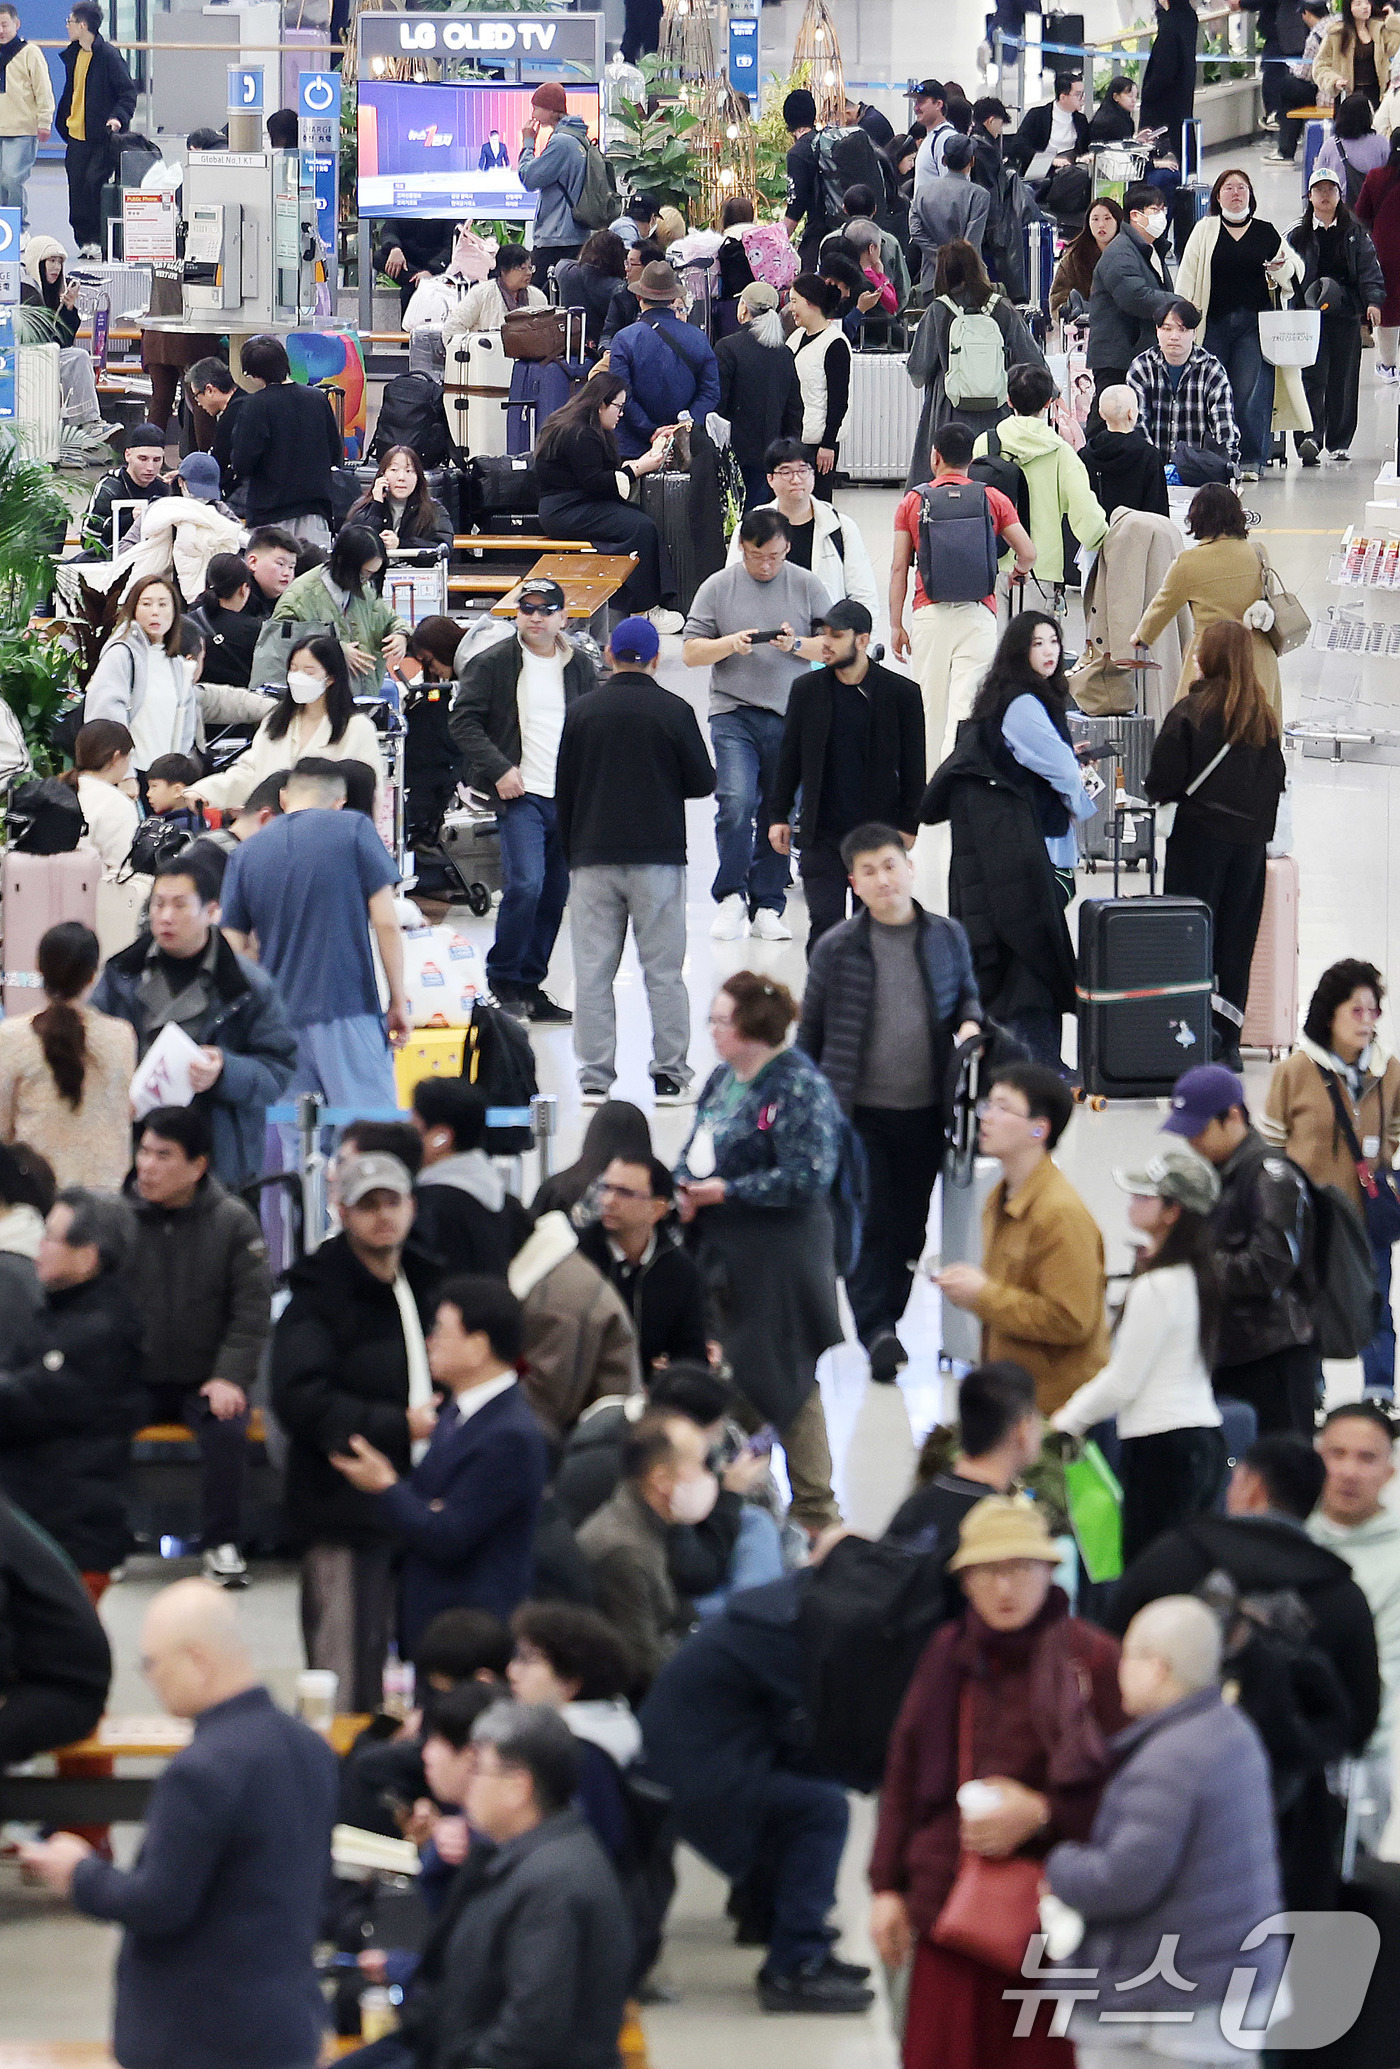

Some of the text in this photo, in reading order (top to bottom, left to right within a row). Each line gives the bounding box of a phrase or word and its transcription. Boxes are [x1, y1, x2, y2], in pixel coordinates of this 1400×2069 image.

[400, 22, 557, 50] LG OLED TV
[200, 155, 224, 164] Global
[243, 157, 253, 165] KT
